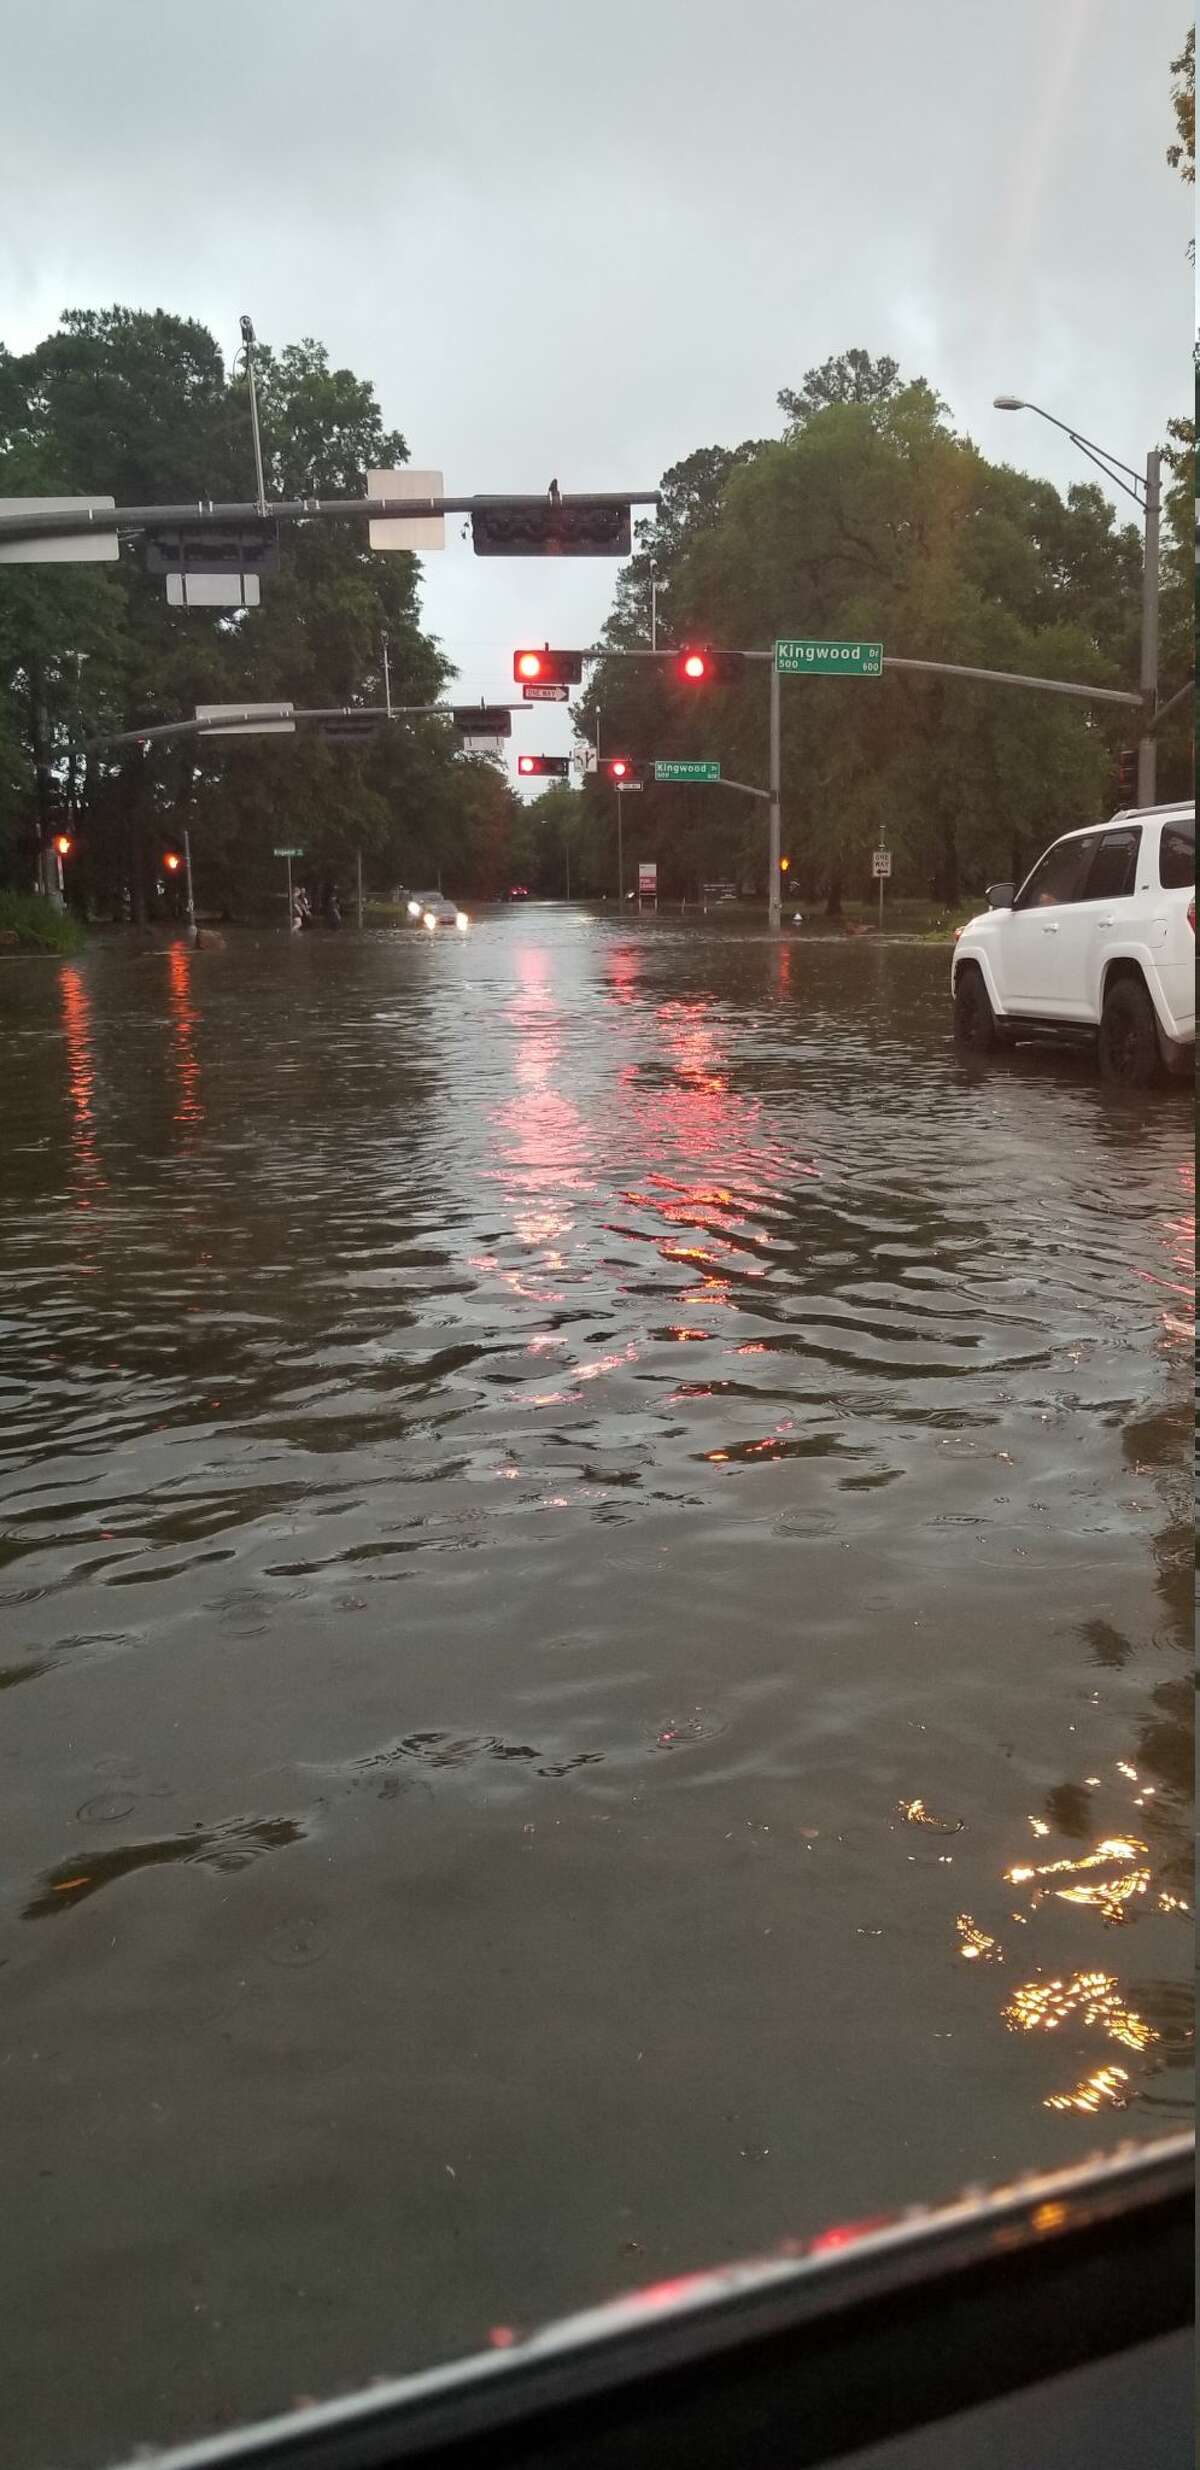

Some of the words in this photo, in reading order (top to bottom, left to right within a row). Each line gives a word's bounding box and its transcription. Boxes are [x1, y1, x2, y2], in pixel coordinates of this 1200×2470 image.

[779, 644, 861, 661] Kingwood
[869, 649, 879, 657] Dr
[779, 660, 798, 668] 500
[863, 662, 879, 671] 600
[657, 764, 706, 773] Kingwood
